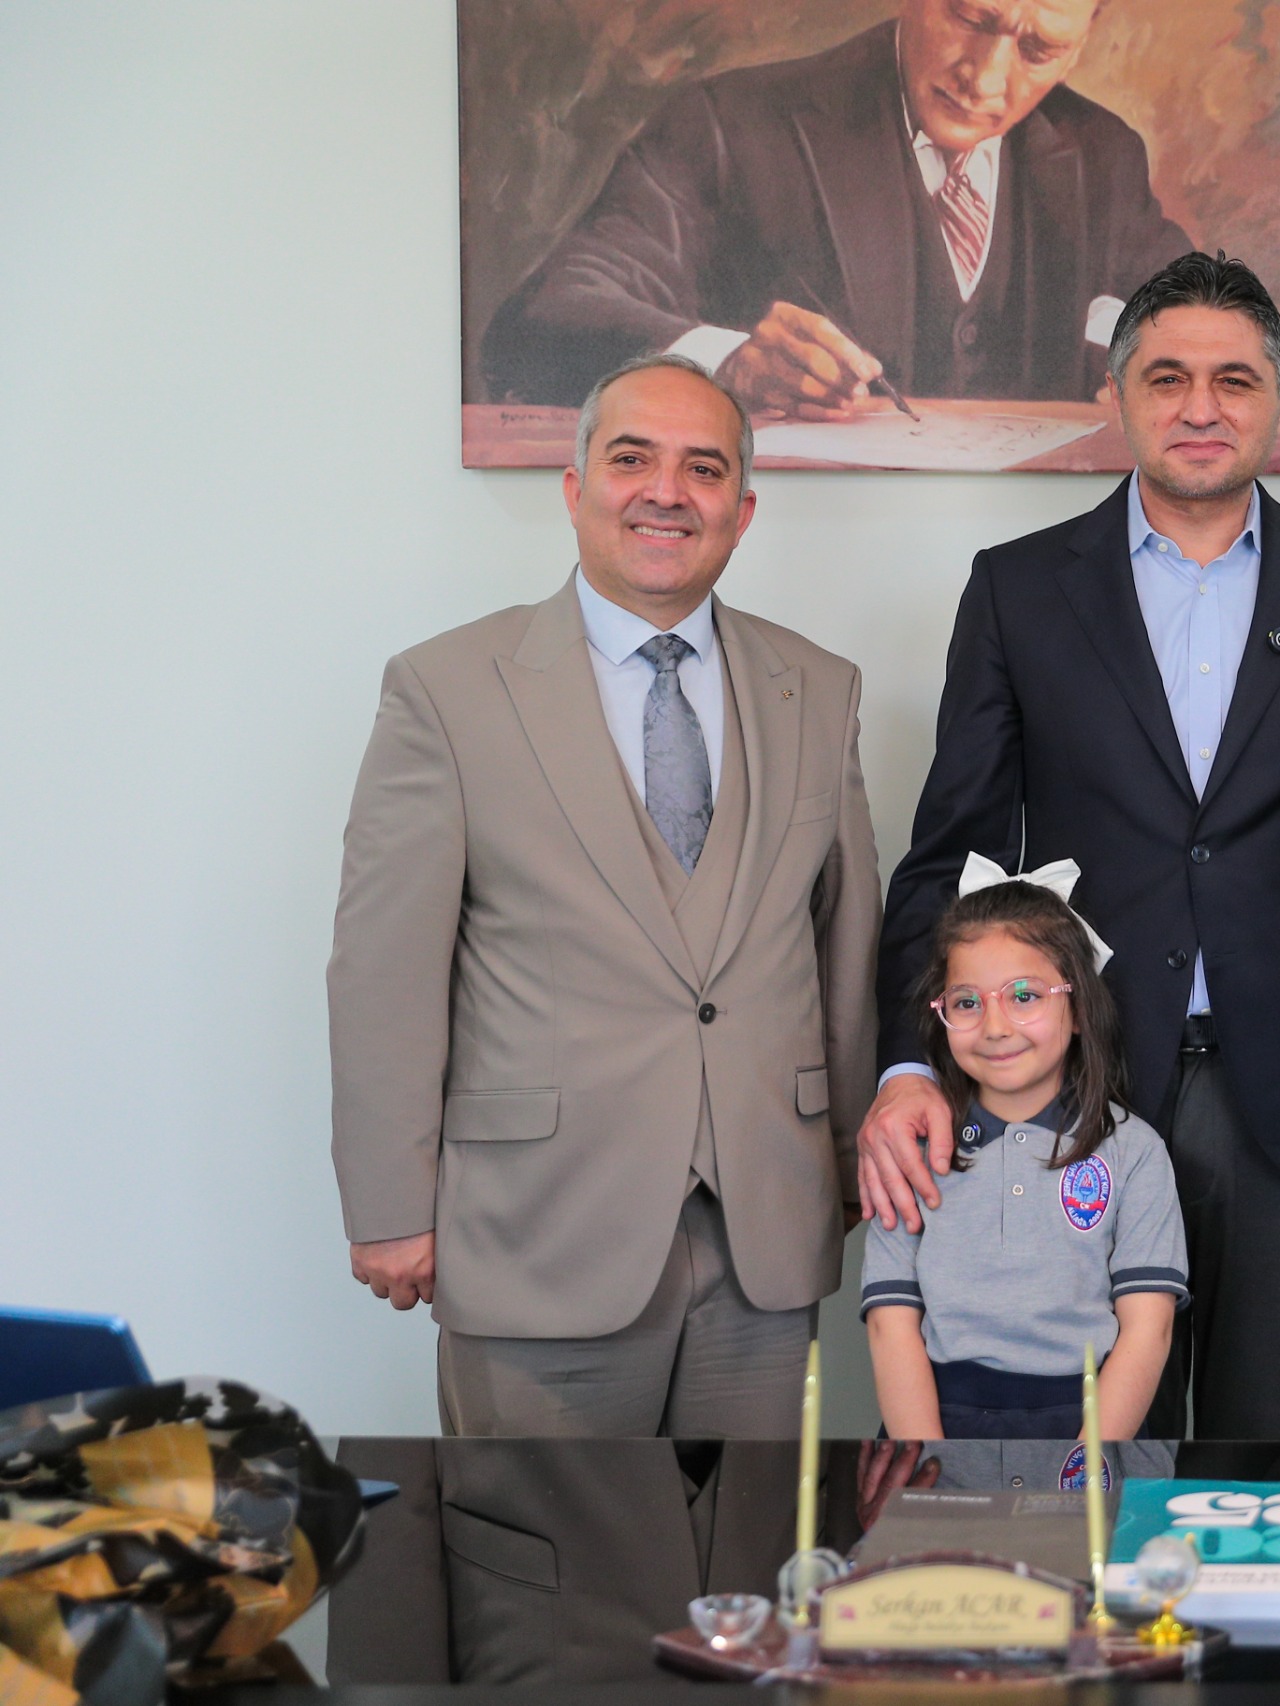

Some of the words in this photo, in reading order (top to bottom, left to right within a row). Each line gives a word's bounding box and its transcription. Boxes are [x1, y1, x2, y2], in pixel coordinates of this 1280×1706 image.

[1099, 1181, 1109, 1201] KULA
[1067, 1206, 1087, 1227] ALİAĞA
[946, 1591, 1028, 1620] ACAR
